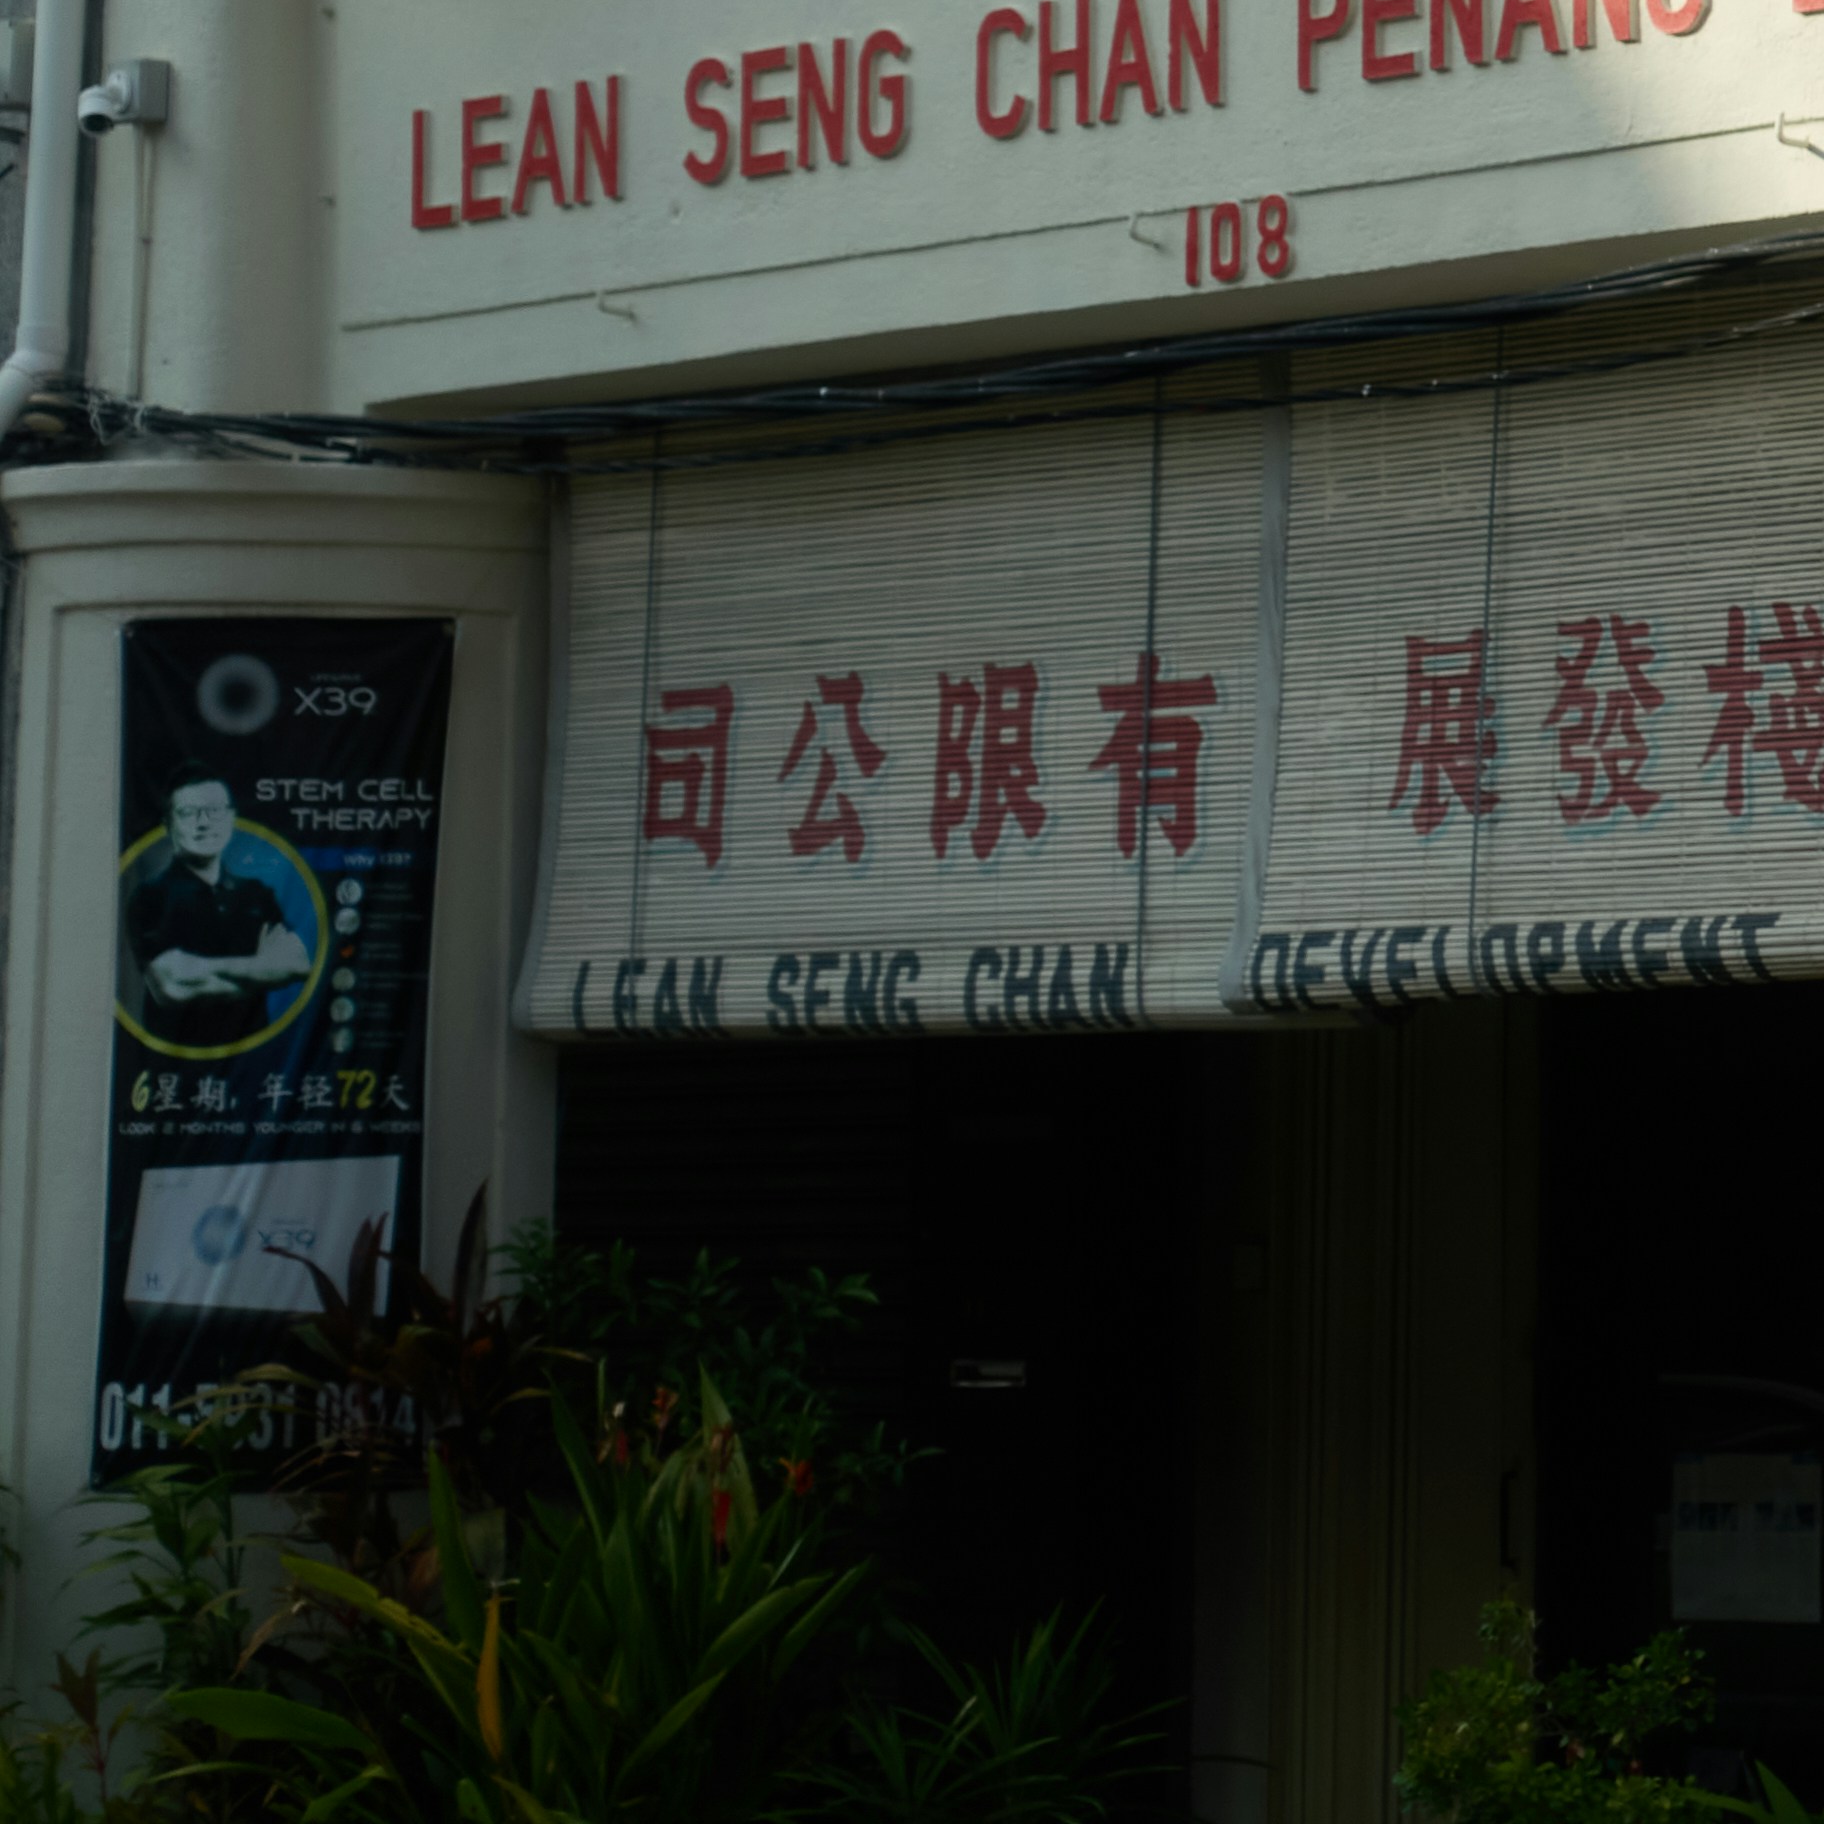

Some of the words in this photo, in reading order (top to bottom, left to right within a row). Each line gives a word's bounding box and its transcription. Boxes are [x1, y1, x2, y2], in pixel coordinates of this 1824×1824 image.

[410, 73, 626, 231] LEAN
[682, 28, 913, 187] SENG
[1183, 193, 1296, 288] 108
[293, 686, 378, 717] X39
[255, 778, 344, 802] STEM
[357, 778, 435, 802] CELL
[290, 807, 433, 831] THERAPY
[571, 955, 730, 1039] LEAN
[765, 948, 927, 1038] SENG
[963, 942, 1139, 1034] CHAN
